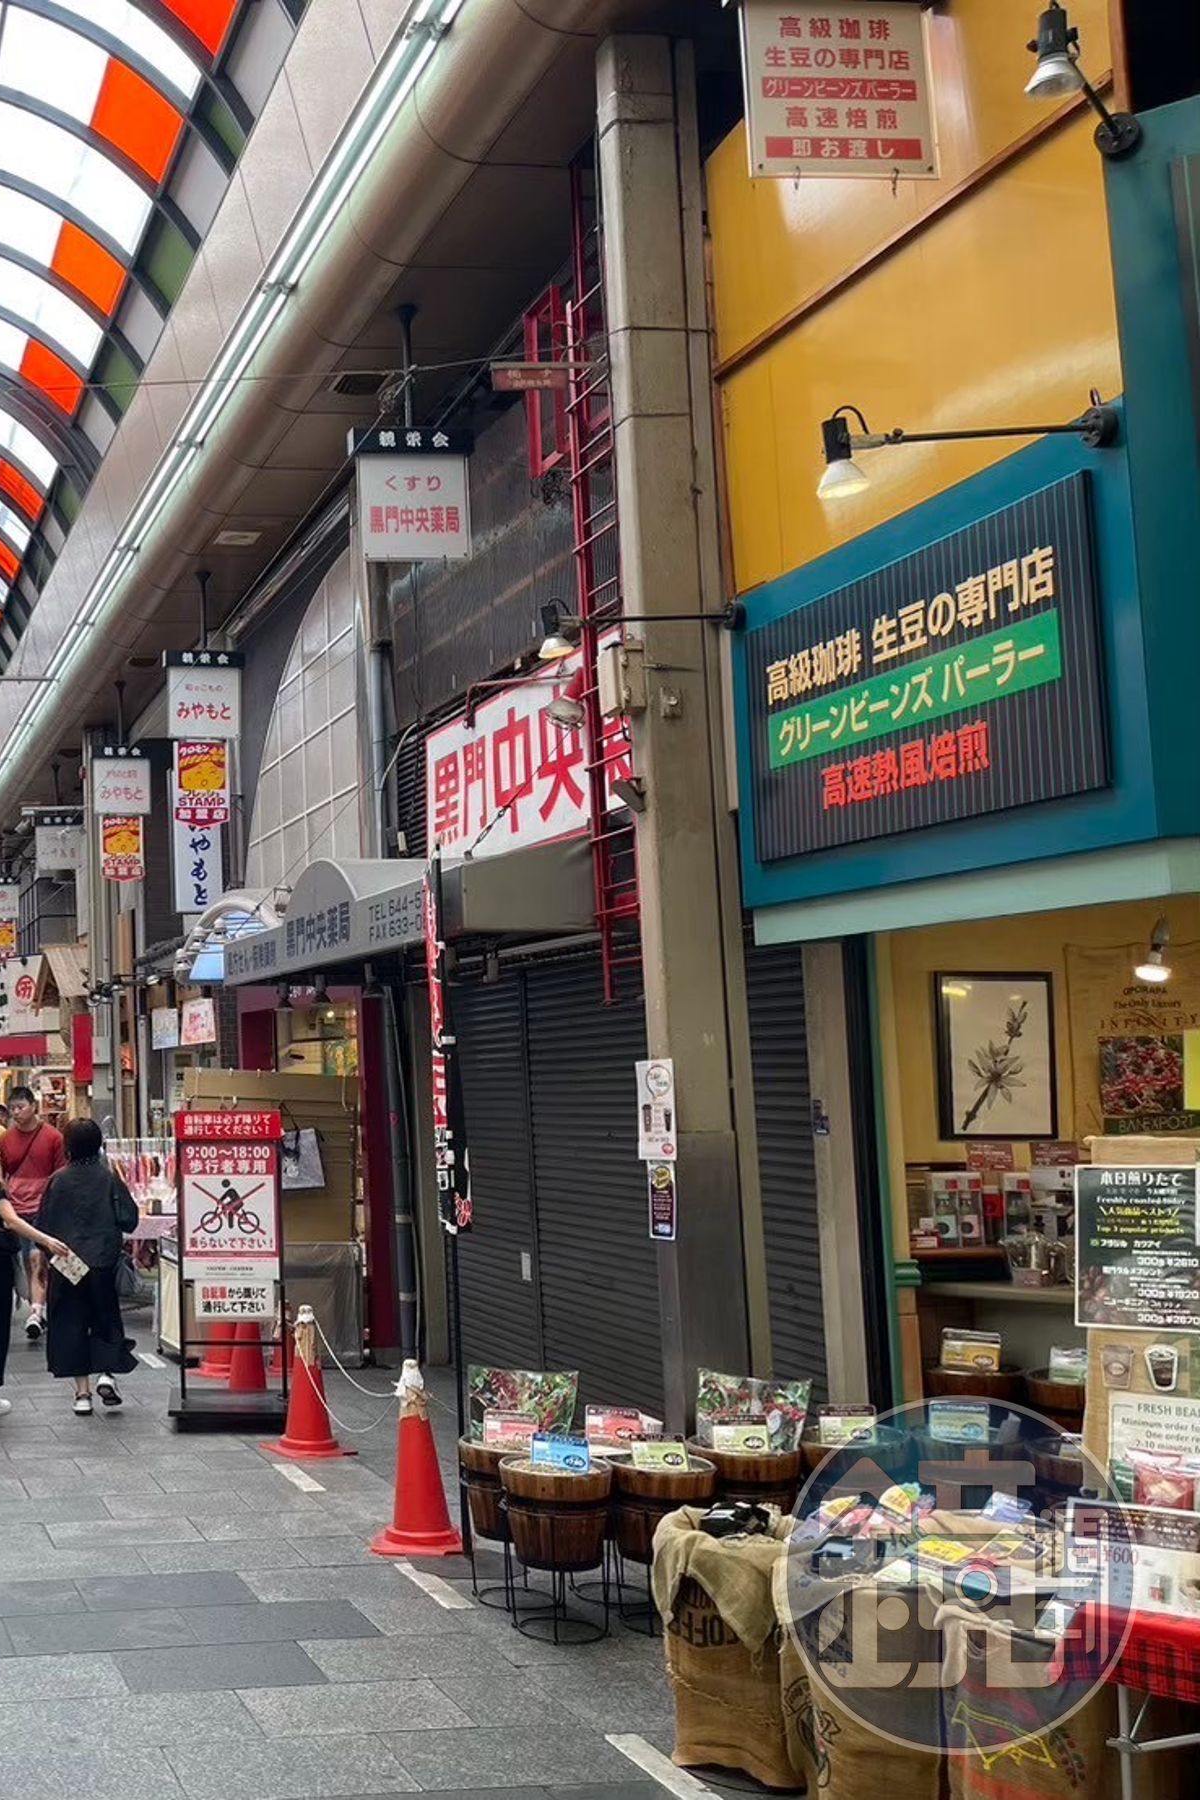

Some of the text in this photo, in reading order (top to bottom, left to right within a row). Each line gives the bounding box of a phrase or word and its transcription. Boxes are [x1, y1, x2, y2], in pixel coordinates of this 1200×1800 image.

[778, 16, 891, 41] 高級珈琲
[764, 47, 911, 71] 生豆の専門店
[784, 105, 899, 129] 高速焙煎
[791, 138, 896, 159] 即お渡し
[385, 475, 442, 492] くすり
[369, 506, 460, 534] 黒門中央薬局
[766, 544, 1056, 706] 高級珈琲 生豆の専門店
[778, 638, 1046, 758] グリーンビーンズ パーラー
[176, 701, 232, 721] みやもと
[820, 719, 990, 812] 高速熱風焙煎
[99, 786, 145, 801] みやもと
[177, 797, 227, 807] STAMP
[177, 808, 226, 820] 加盟店
[369, 890, 423, 924] TEL 644-5
[286, 900, 351, 959] 黒門中央薬局
[369, 913, 423, 944] FAX 633-0
[183, 1113, 272, 1125] 自転車は必ず降りて
[188, 1159, 268, 1175] 歩行者専用
[1100, 1171, 1183, 1186] 本日煎りたて
[201, 1286, 267, 1300] 自転車から降りて
[201, 1299, 266, 1313] 通行して下さい
[1138, 1403, 1172, 1416] FRESH
[1121, 1417, 1163, 1429] Minimum
[1164, 1422, 1188, 1431] order
[1146, 1430, 1163, 1439] One
[1165, 1433, 1189, 1442] order
[1157, 1443, 1192, 1453] minutes
